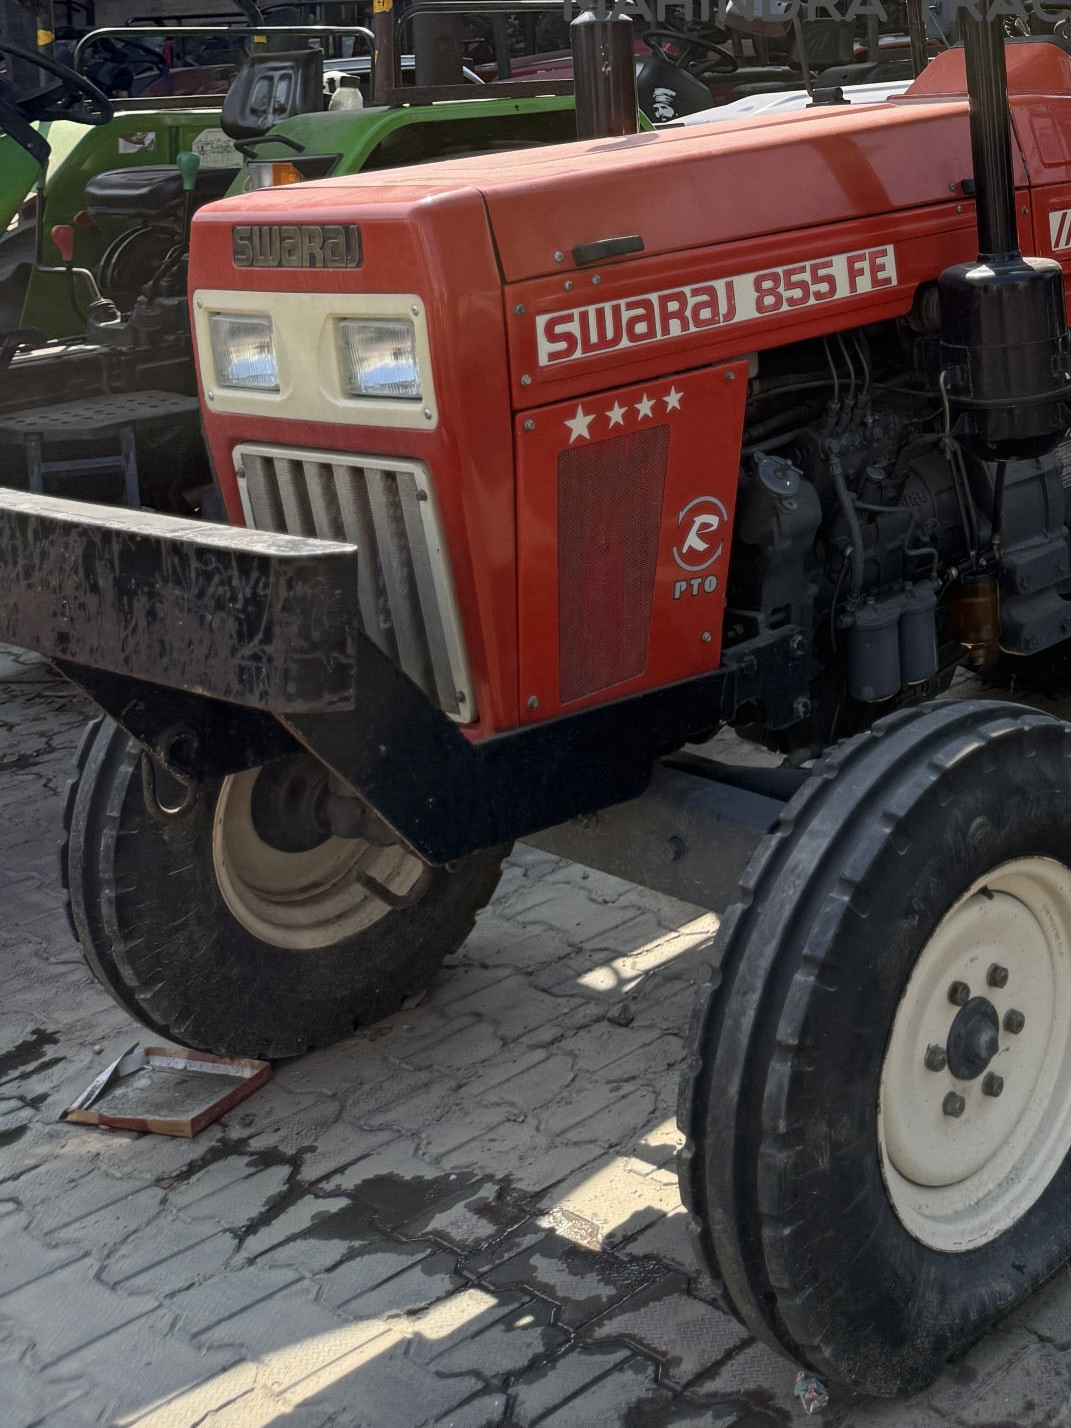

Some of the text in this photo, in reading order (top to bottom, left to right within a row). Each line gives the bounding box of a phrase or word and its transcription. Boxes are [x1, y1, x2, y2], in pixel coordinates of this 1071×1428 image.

[754, 260, 837, 315] 855
[847, 248, 893, 294] FE
[682, 514, 719, 554] R
[673, 574, 718, 600] PTO
